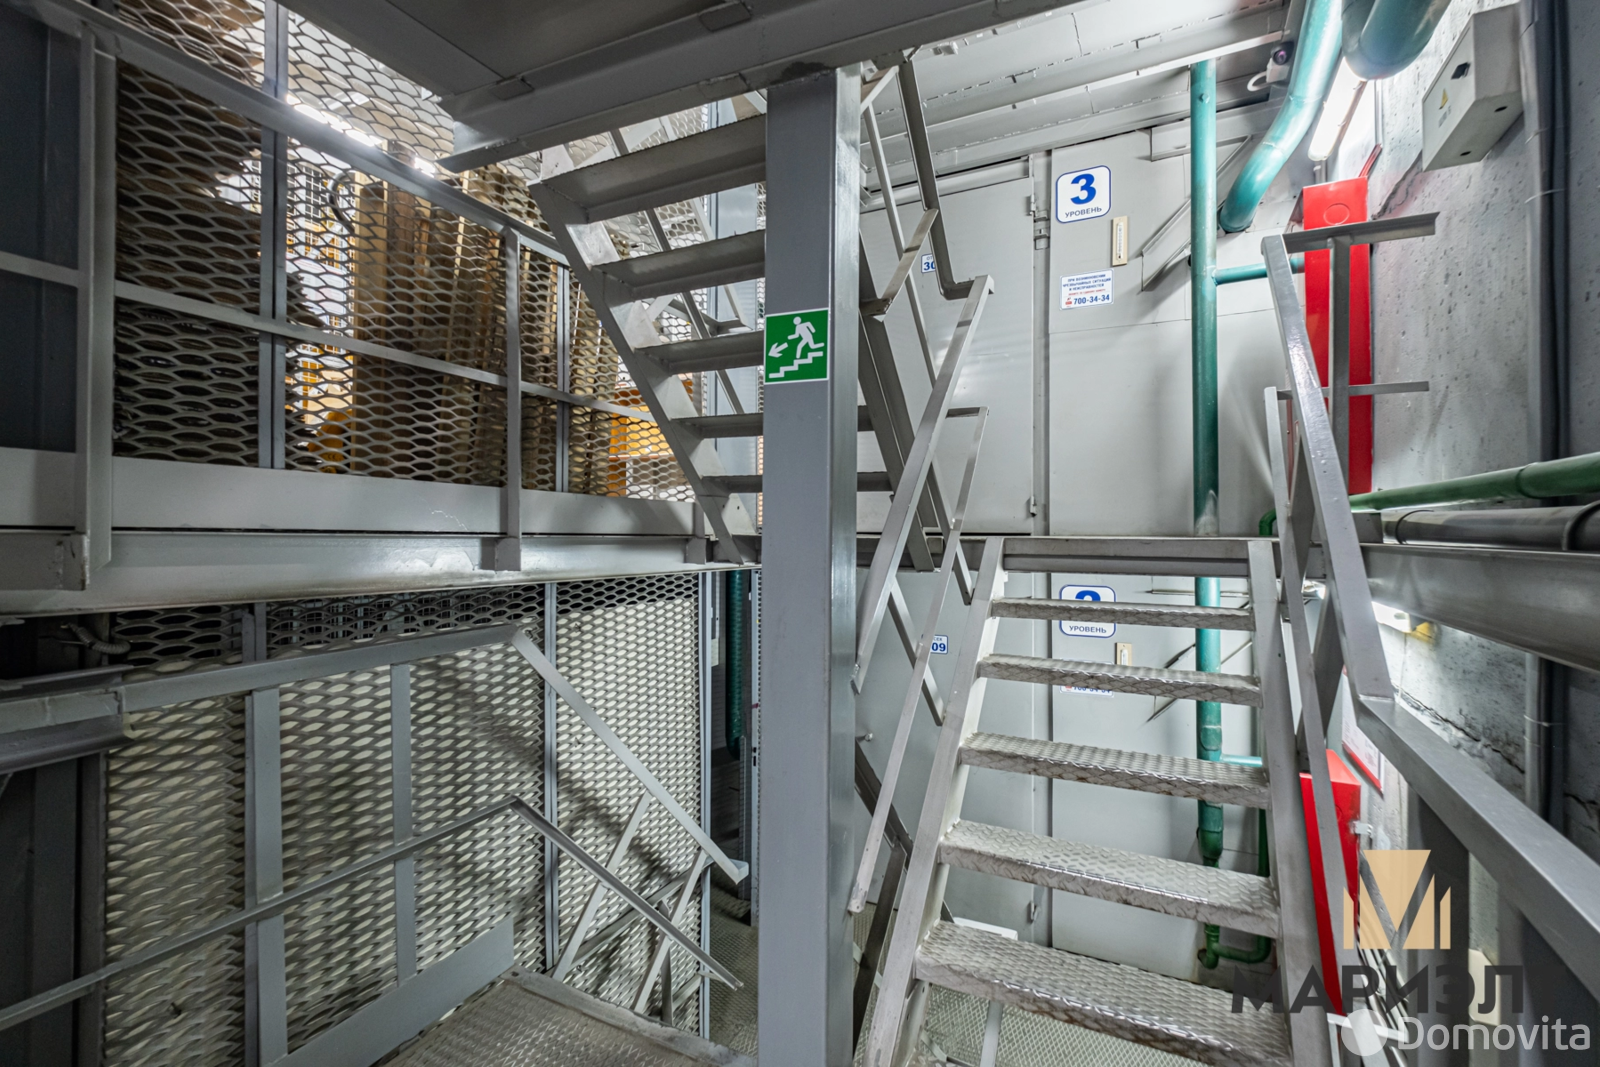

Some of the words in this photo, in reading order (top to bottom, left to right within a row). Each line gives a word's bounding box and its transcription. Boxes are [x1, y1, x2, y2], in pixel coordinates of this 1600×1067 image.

[1070, 173, 1097, 205] 3
[1065, 206, 1103, 218] УРОВЕНЬ
[924, 261, 936, 271] 30
[1074, 294, 1110, 305] 700-34-34
[1069, 625, 1107, 634] УРОВЕНЬ
[931, 642, 946, 652] 09
